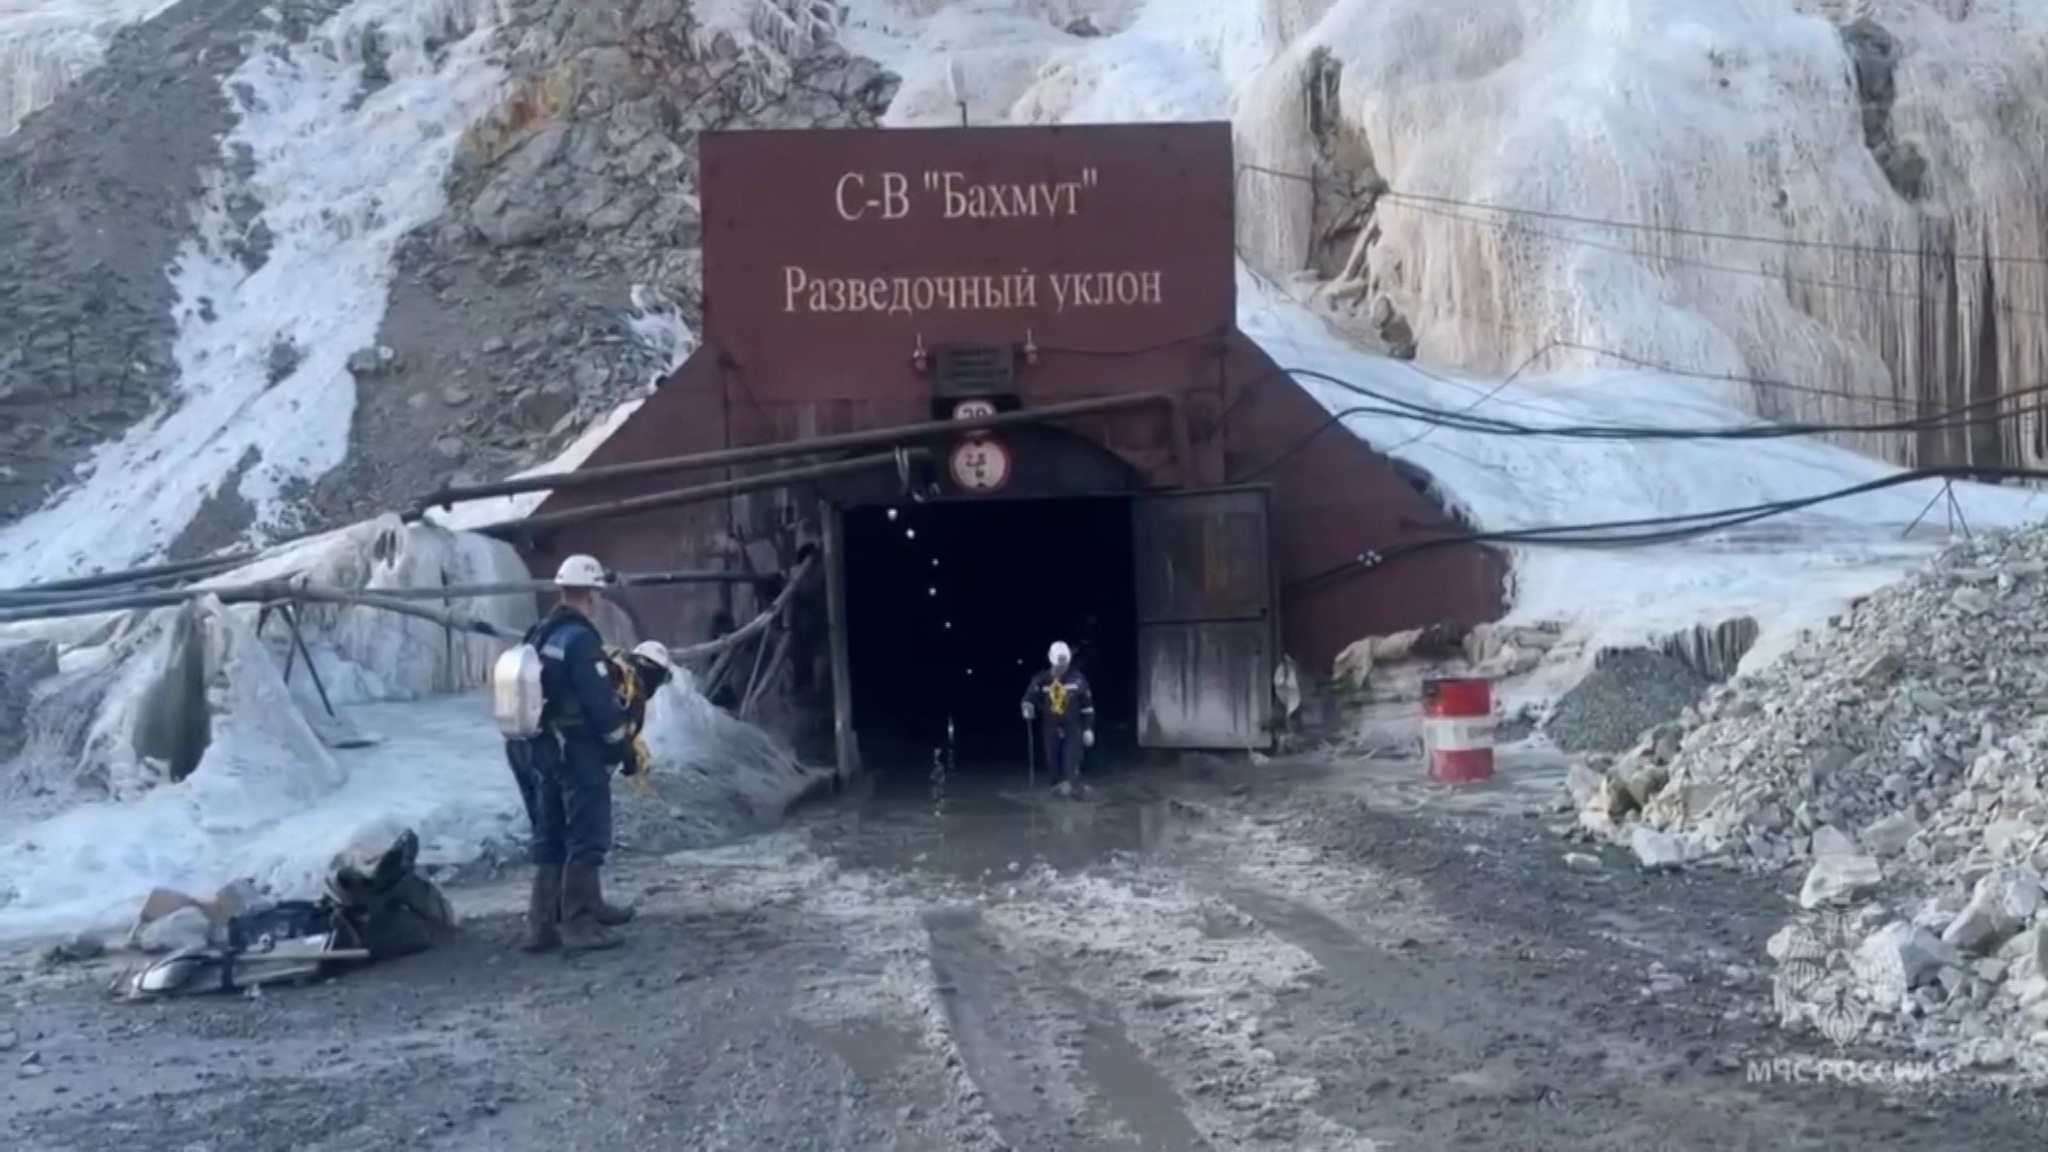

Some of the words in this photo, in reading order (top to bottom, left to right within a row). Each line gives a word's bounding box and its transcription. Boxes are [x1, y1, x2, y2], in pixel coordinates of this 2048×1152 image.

[834, 170, 911, 221] С-В
[783, 265, 1038, 317] Разведочный
[1049, 268, 1163, 314] уклон
